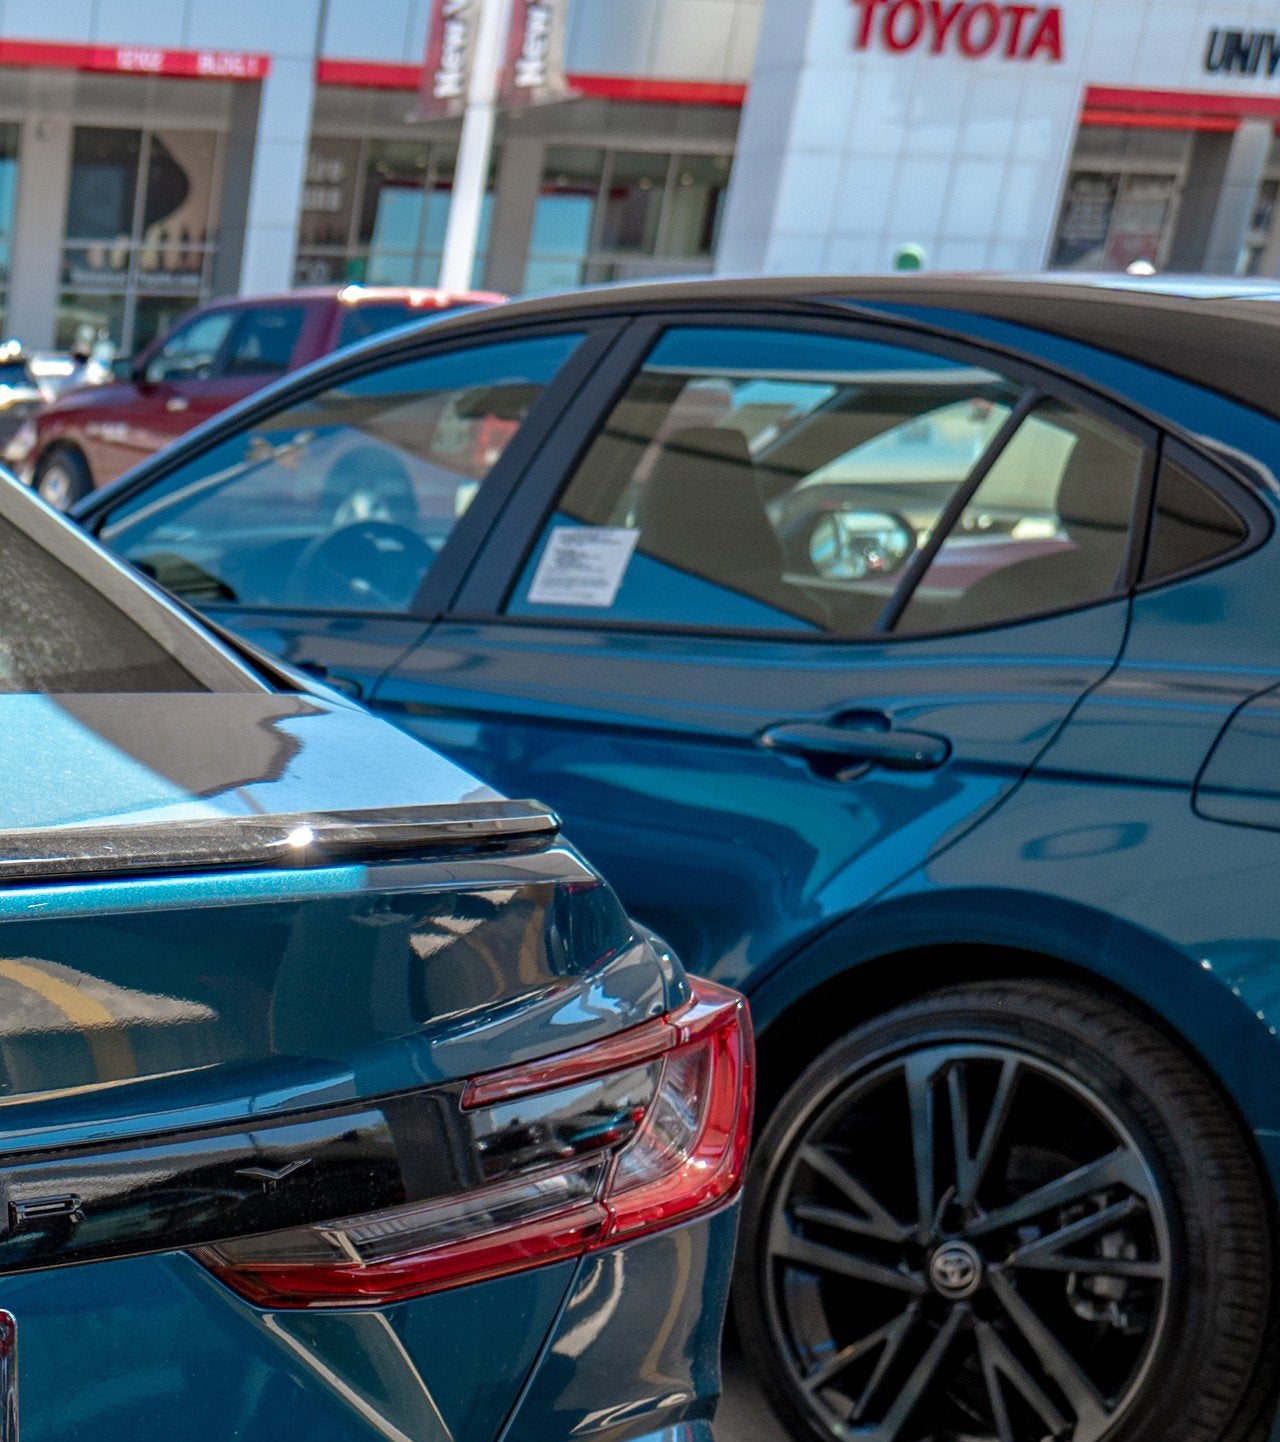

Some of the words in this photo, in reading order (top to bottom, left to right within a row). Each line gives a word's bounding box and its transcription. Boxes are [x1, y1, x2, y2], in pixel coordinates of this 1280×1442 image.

[434, 22, 464, 97] New
[516, 8, 546, 87] New
[851, 0, 1062, 63] TOYOTA
